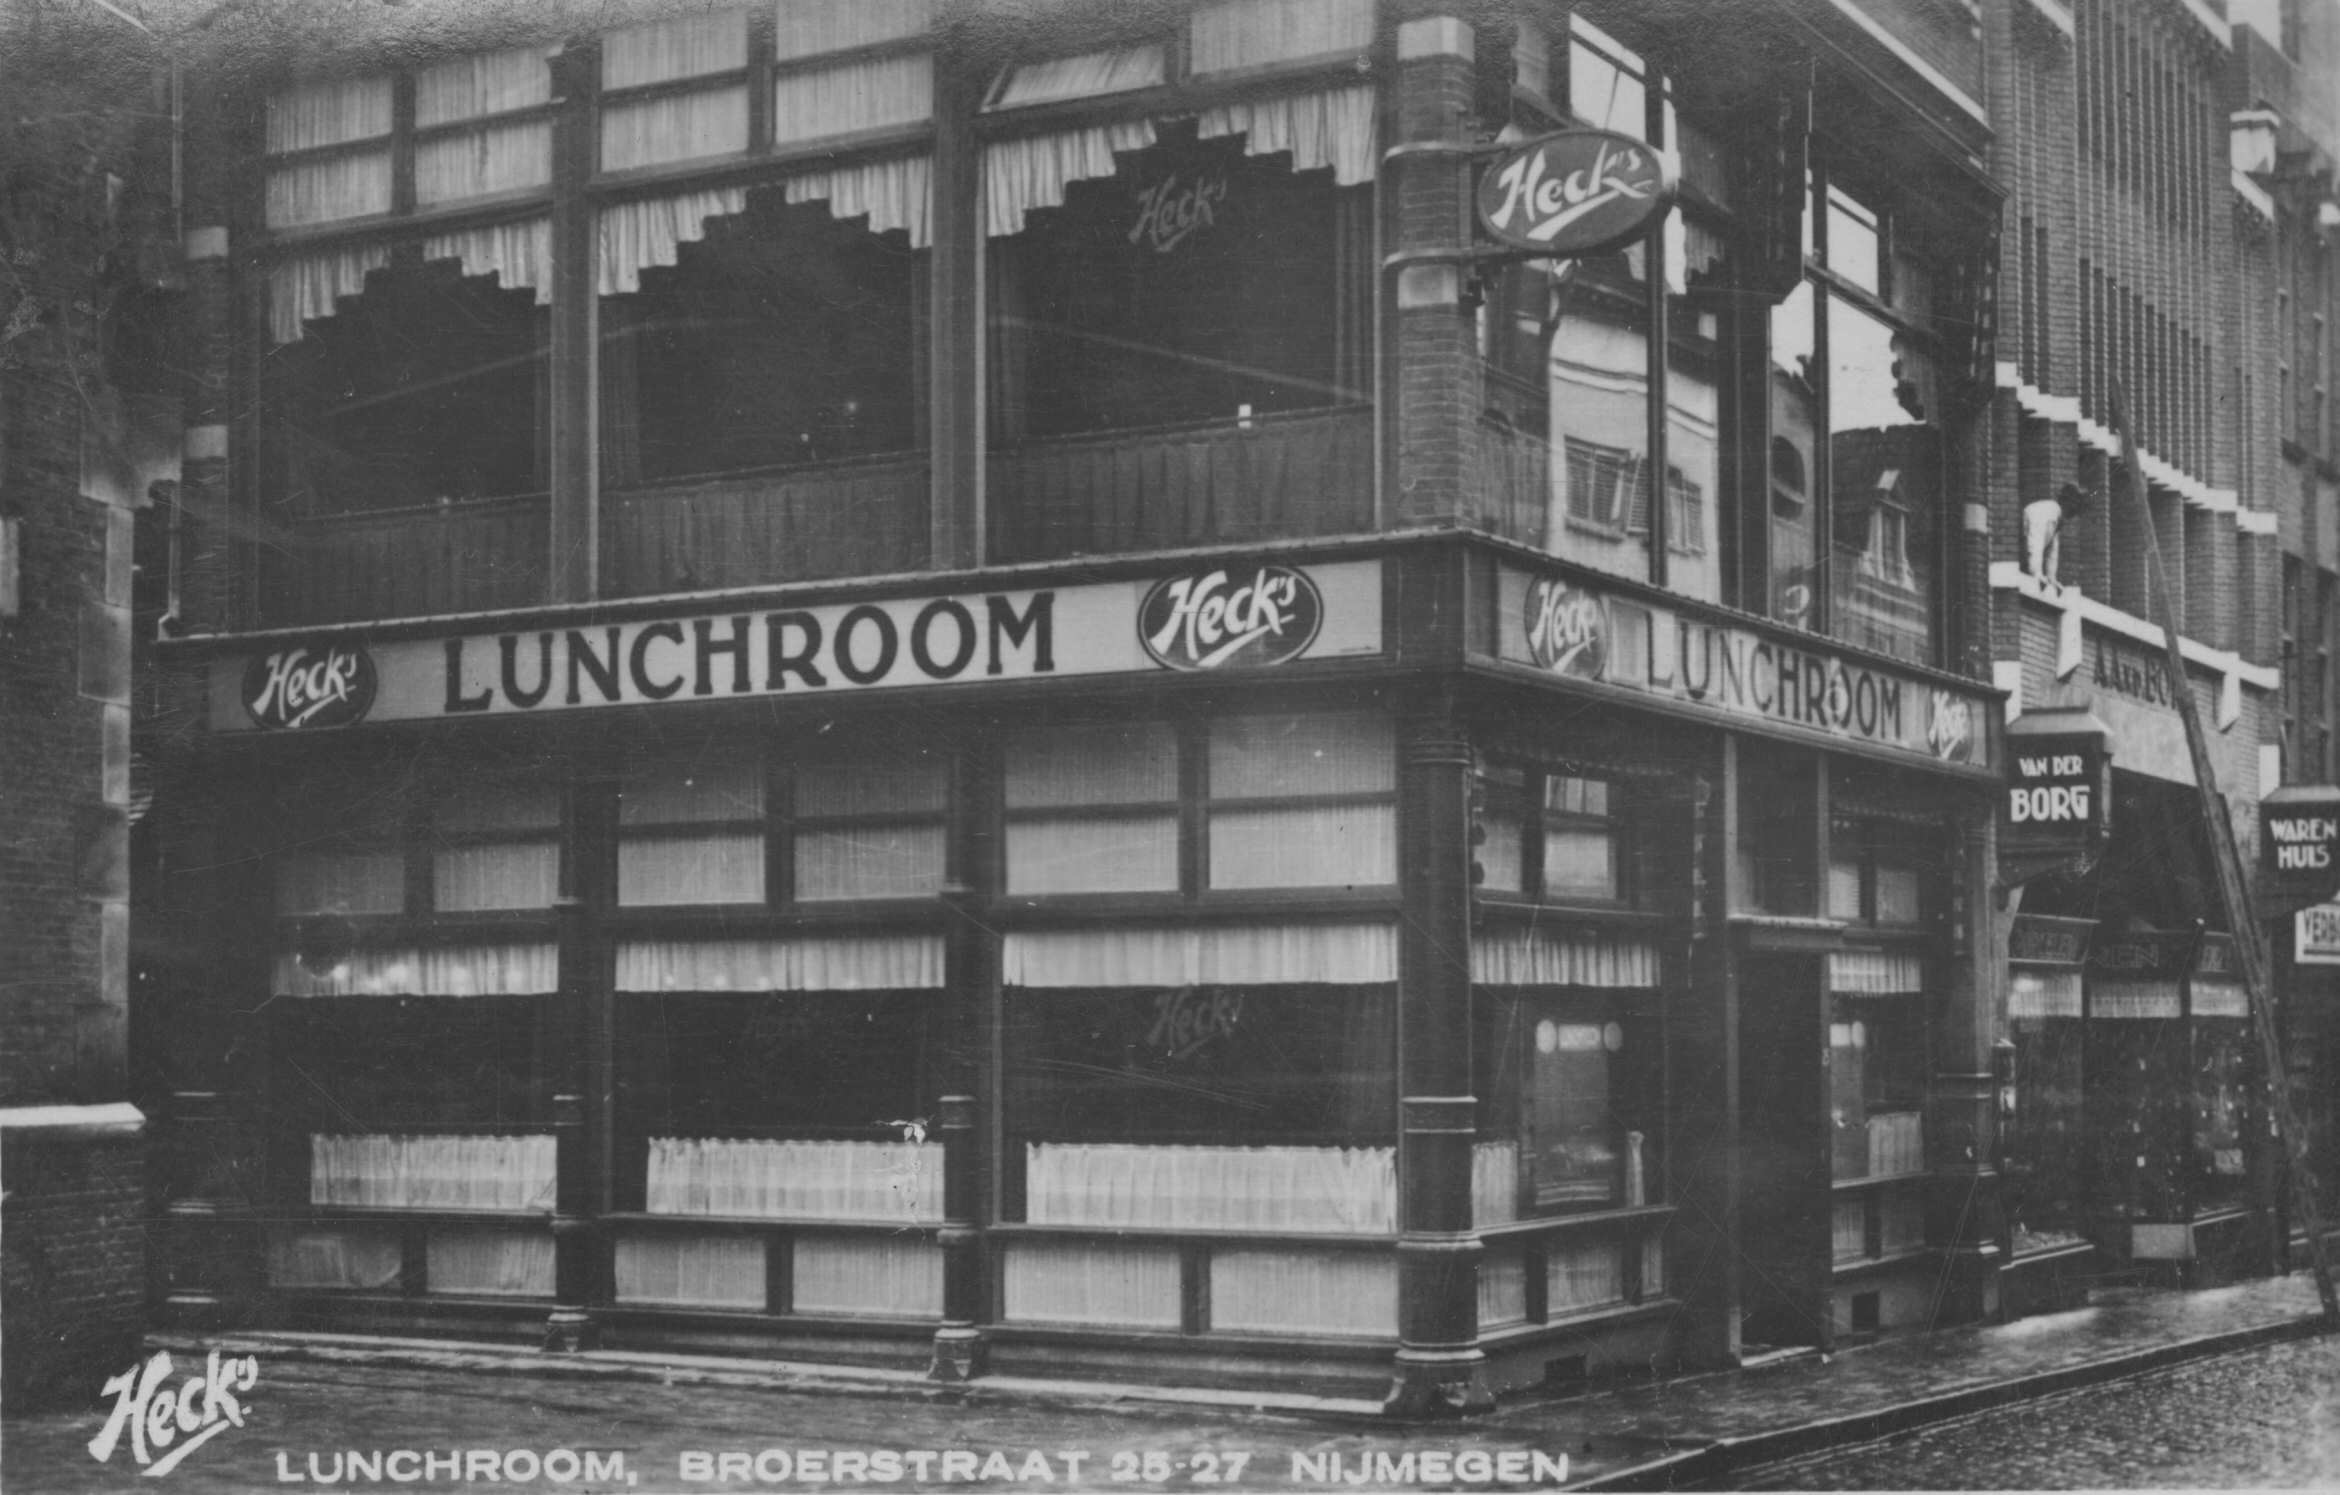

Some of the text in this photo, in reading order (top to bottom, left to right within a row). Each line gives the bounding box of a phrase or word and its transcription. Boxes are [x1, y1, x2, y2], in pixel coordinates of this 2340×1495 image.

[1149, 566, 1296, 668] Heck's
[444, 591, 1055, 713] LUNCHROOM
[1646, 608, 1903, 740] LUNCHROOM
[2019, 755, 2083, 776] VAN DER
[2010, 785, 2090, 822] BORG
[2269, 818, 2338, 843] WAREN
[2277, 844, 2331, 869] HUIS
